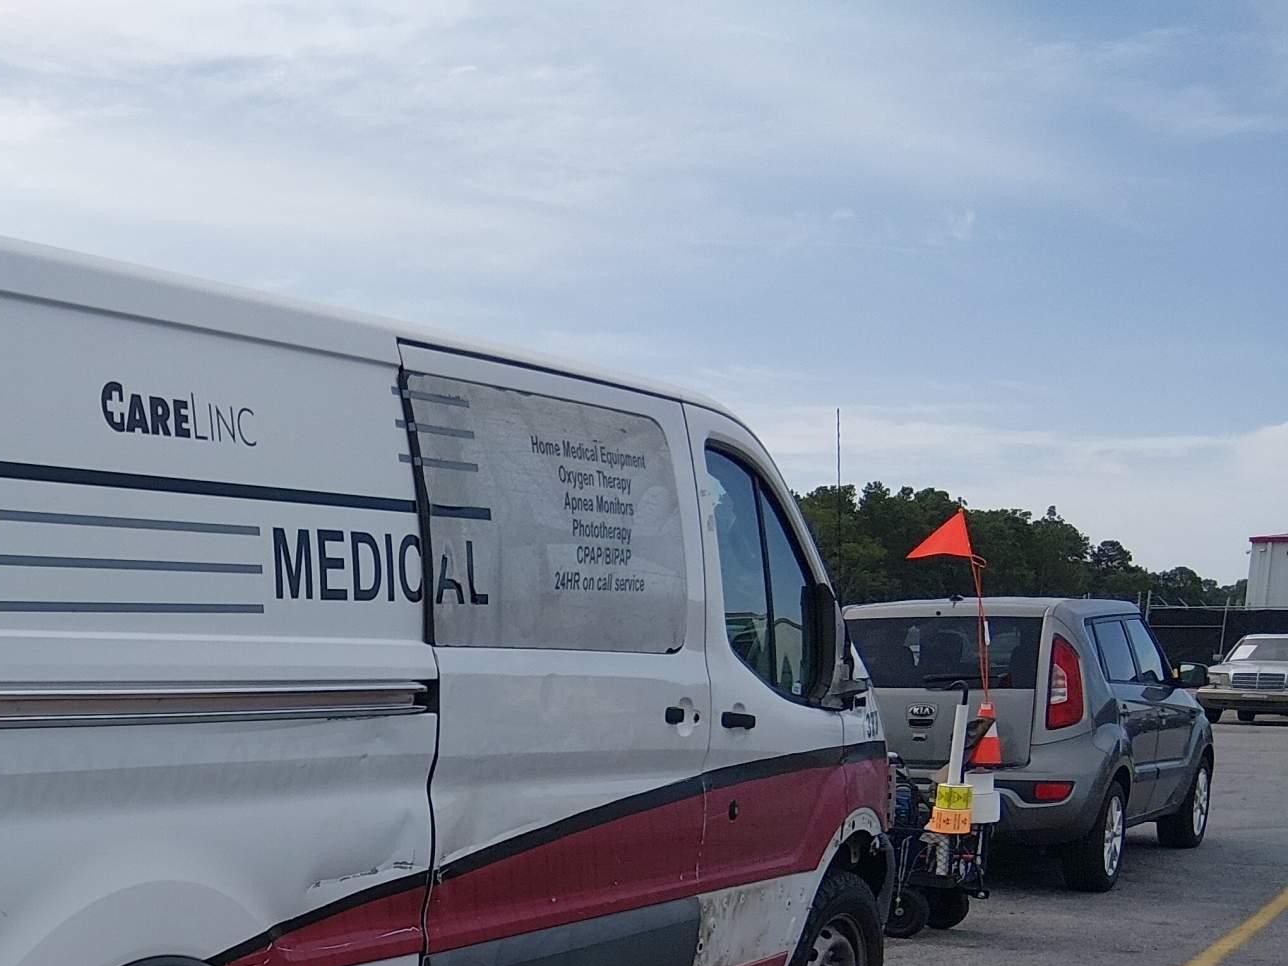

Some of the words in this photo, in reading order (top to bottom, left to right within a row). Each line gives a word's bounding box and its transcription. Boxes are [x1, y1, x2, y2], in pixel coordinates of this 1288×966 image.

[530, 435, 561, 457] Home
[562, 439, 598, 464] Medical
[600, 446, 646, 470] Equipment
[558, 465, 594, 490] Oxygen
[596, 469, 632, 495] Therapy
[564, 492, 594, 514] Apnea
[595, 495, 634, 516] Monitors
[572, 519, 632, 544] Phototherapy
[272, 526, 489, 606] MEDICAL
[554, 571, 581, 590] 24HR
[582, 576, 594, 590] on
[596, 574, 613, 591] call
[614, 575, 645, 592] service
